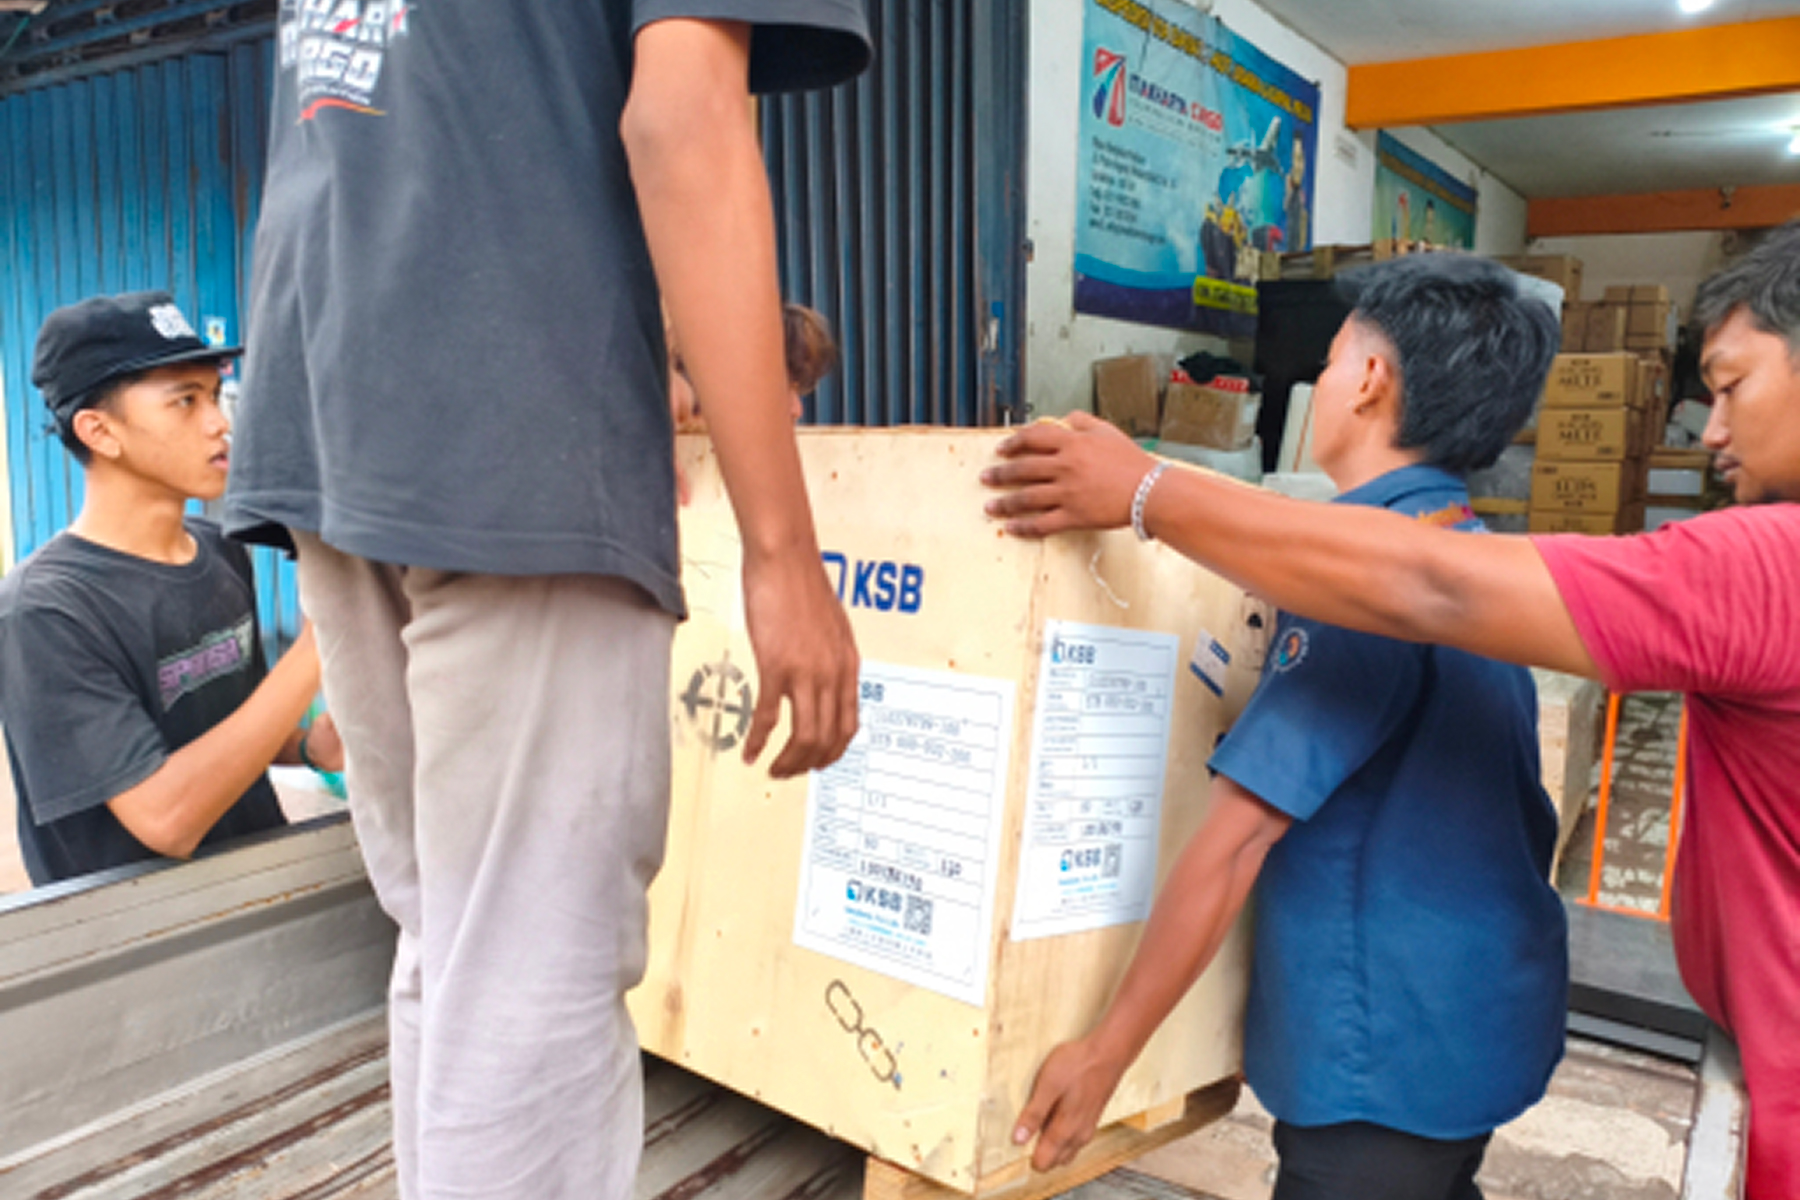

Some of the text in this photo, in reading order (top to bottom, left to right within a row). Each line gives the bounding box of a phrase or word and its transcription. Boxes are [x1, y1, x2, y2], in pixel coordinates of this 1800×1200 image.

[852, 560, 924, 614] KSB
[1067, 644, 1097, 664] KSB
[858, 680, 885, 703] SB
[864, 884, 903, 913] KSB
